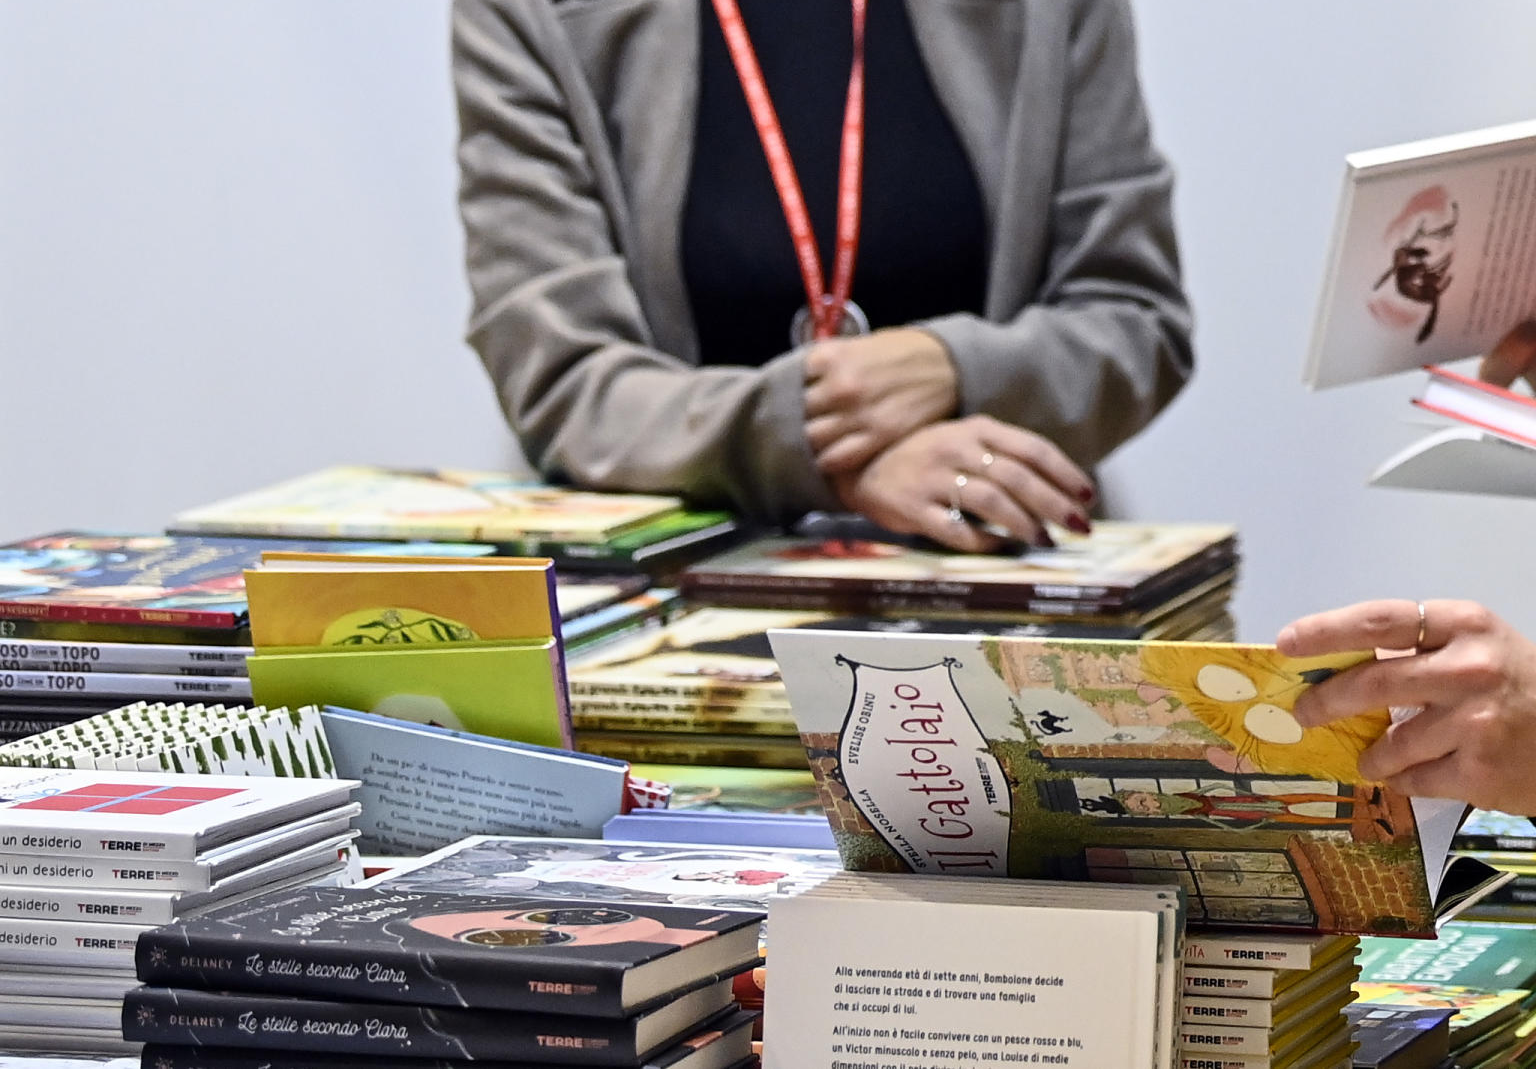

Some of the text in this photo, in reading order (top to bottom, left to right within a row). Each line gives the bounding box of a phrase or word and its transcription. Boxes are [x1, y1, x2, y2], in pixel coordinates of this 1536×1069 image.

[61, 646, 100, 660] TOPO
[53, 661, 92, 672] TOPO
[47, 675, 85, 689] TOPO
[849, 692, 876, 765] EVELISE OBINU
[884, 684, 974, 839] Gattolaio
[980, 774, 998, 805] TERRE
[858, 788, 927, 869] STELLA NOSELLA
[3, 835, 82, 849] un desiderio
[100, 840, 141, 851] TERRE
[13, 865, 28, 876] un
[33, 863, 94, 878] desiderio
[112, 869, 154, 880] TERRE
[1, 897, 60, 912] desiderio
[77, 903, 118, 915] TERRE
[0, 931, 57, 946] desiderio
[75, 937, 116, 949] TERRE
[1224, 949, 1264, 960] TERRE
[181, 956, 233, 970] DELANEY
[245, 953, 264, 976] Le
[268, 959, 301, 975] stelle
[307, 963, 361, 979] secondo
[835, 966, 1064, 986] Alla veneranda età di sette anni, Bombolone decide
[1185, 977, 1225, 987] TERRE
[528, 981, 572, 994] TERRE
[834, 983, 843, 993] di
[846, 984, 880, 995] lasciare
[883, 985, 891, 995] la
[894, 987, 923, 997] strada
[934, 988, 942, 998] di
[945, 989, 977, 1000] trovare
[980, 992, 996, 1001] una
[999, 991, 1036, 1004] famiglia
[834, 1001, 917, 1014] che si occupi di lui.
[1185, 1006, 1225, 1017] TERRE
[169, 1014, 225, 1028] DELANEY
[238, 1011, 258, 1033] Le
[262, 1017, 298, 1033] stelle
[303, 1019, 361, 1036] secondo
[537, 1035, 583, 1048] TERRE
[833, 1025, 1083, 1049] All'inizio non è facile convivere con un pesce rosso e blu,
[1181, 1033, 1221, 1044] TERRE
[832, 1043, 1069, 1064] un Victor minuscolo e senza pelo, una Louise di medie
[1182, 1060, 1222, 1069] TERRE
